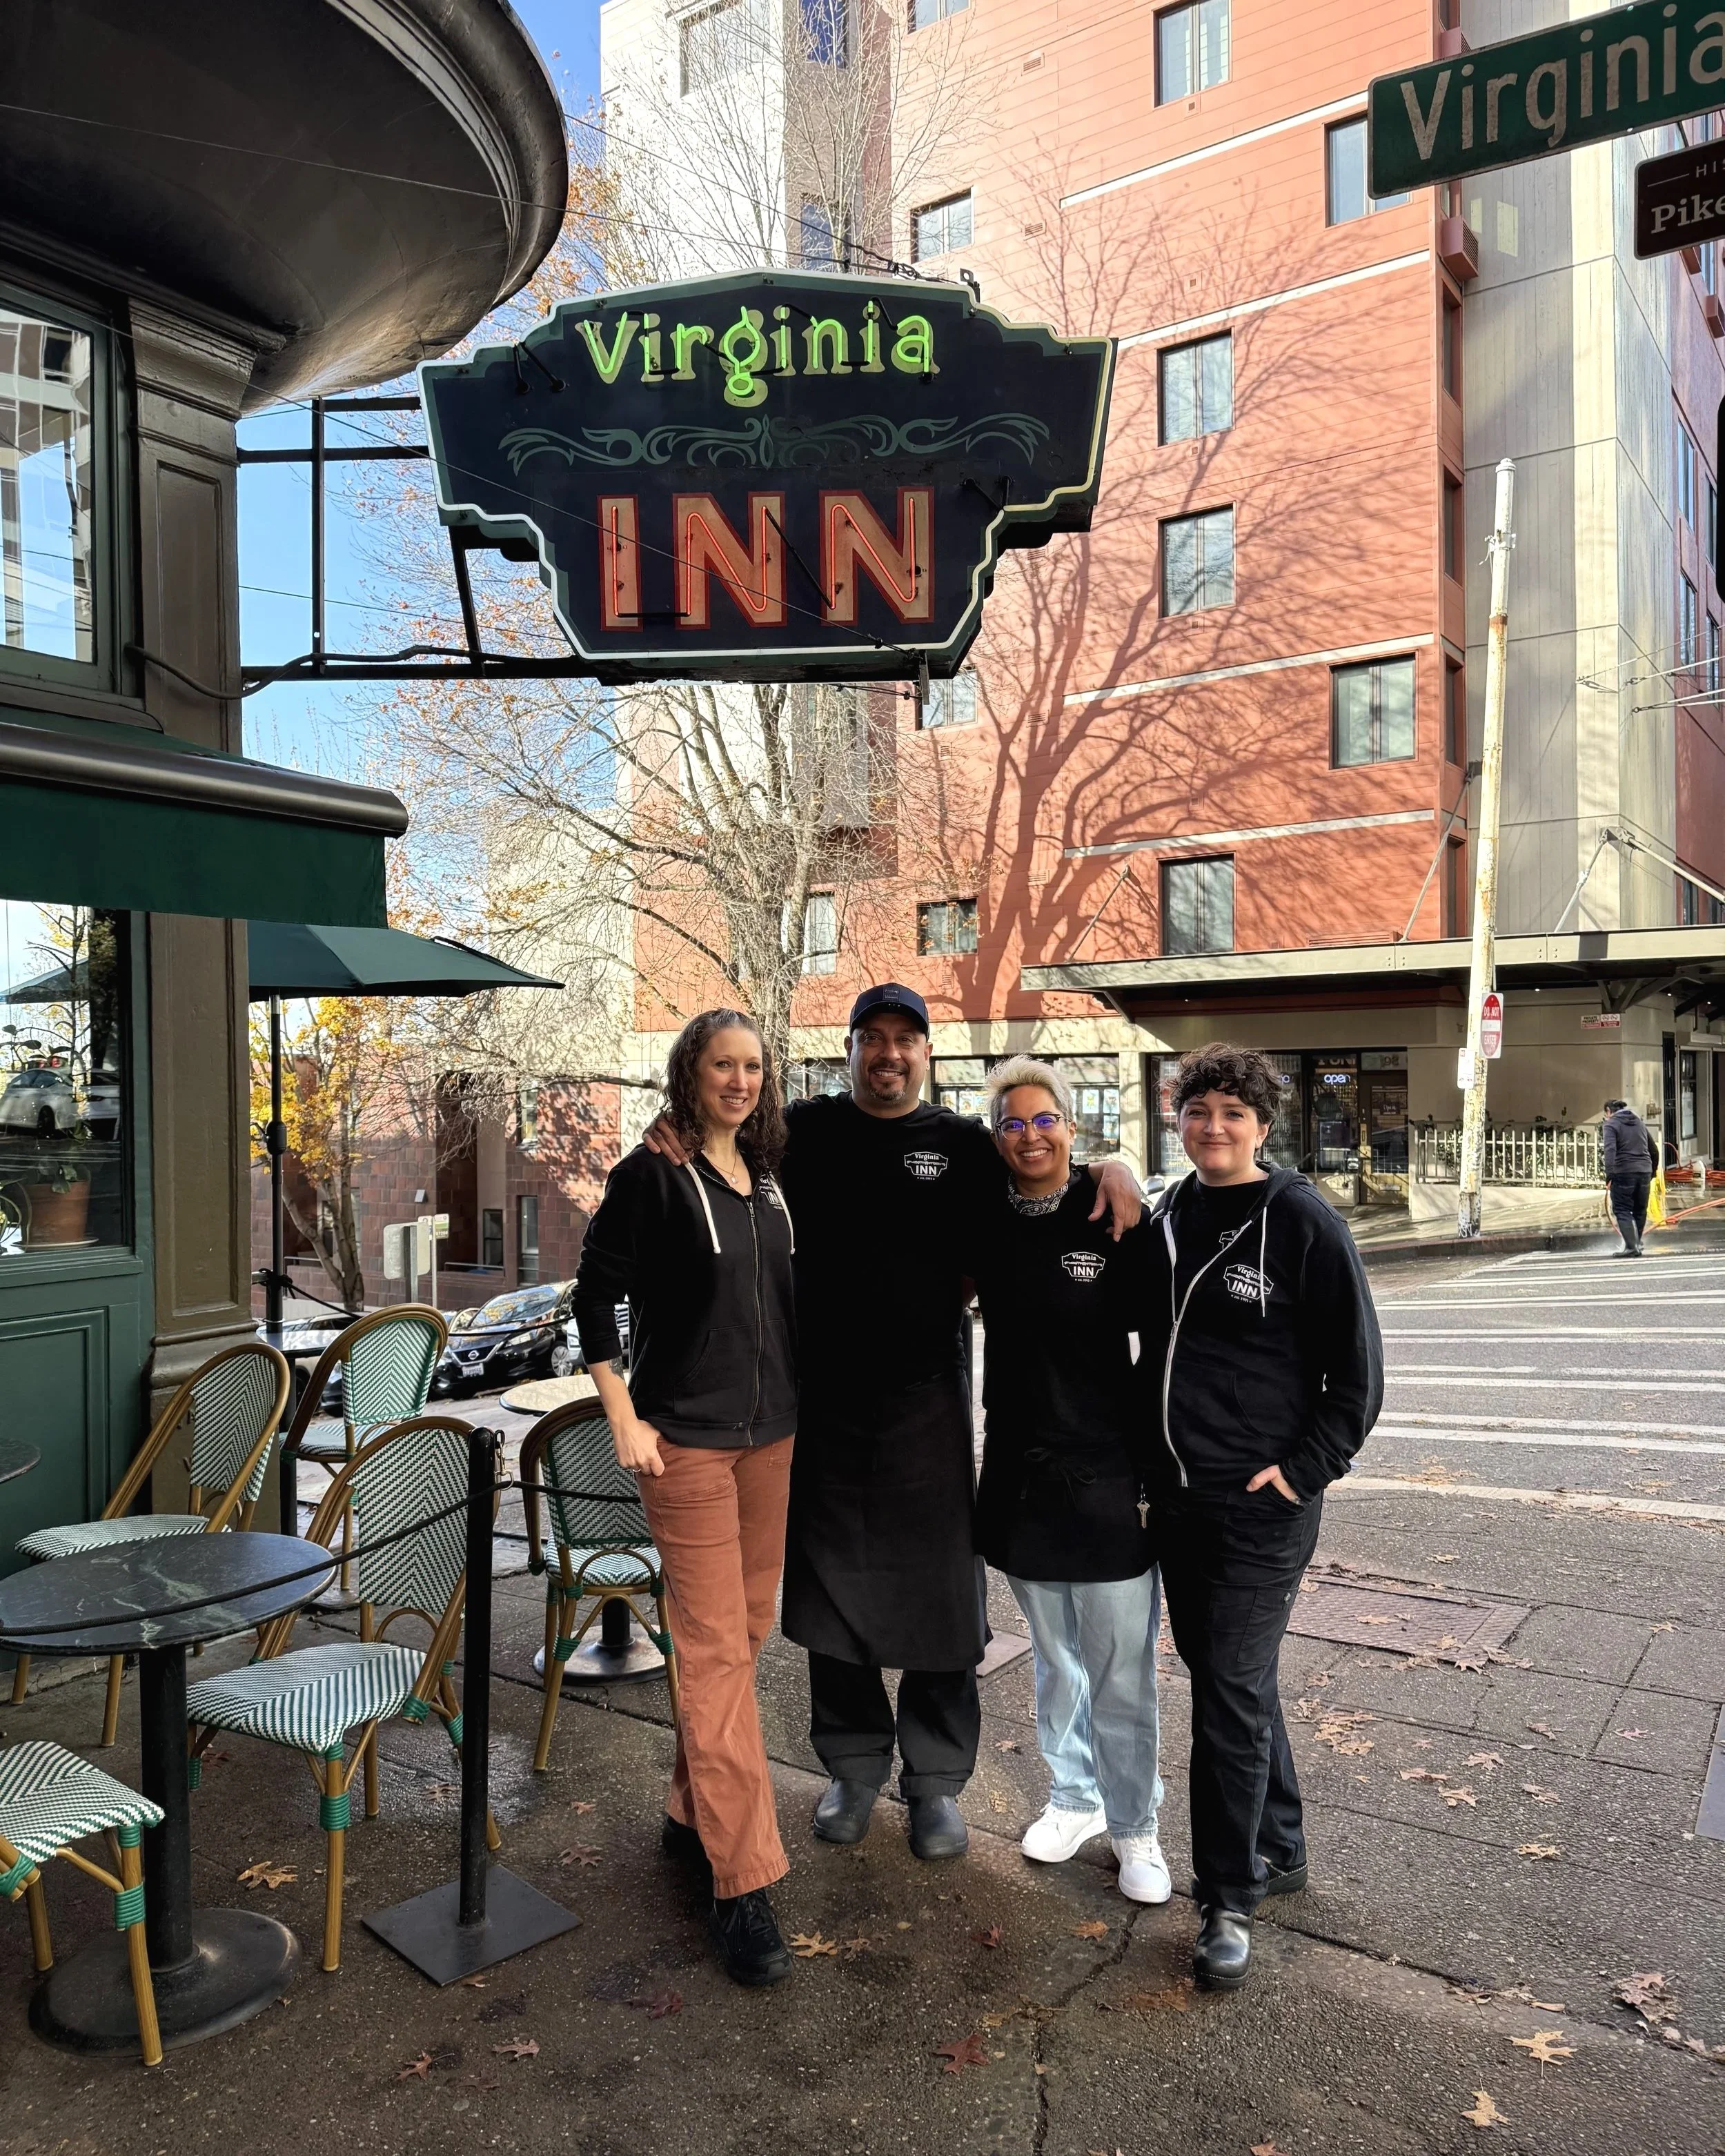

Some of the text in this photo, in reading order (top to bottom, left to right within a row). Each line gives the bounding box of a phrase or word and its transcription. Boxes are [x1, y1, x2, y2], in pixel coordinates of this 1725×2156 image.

[1400, 3, 1725, 160] Virginia
[1650, 194, 1725, 234] Pike
[574, 301, 940, 408] Virginia
[597, 486, 935, 632] INN
[1483, 1006, 1500, 1017] DO NOT
[1483, 1034, 1497, 1045] ENTER
[1323, 1074, 1351, 1085] open
[916, 1165, 937, 1176] INN
[1073, 1265, 1094, 1276] INN
[1237, 1266, 1261, 1280] Virgini
[1232, 1280, 1258, 1298] INN
